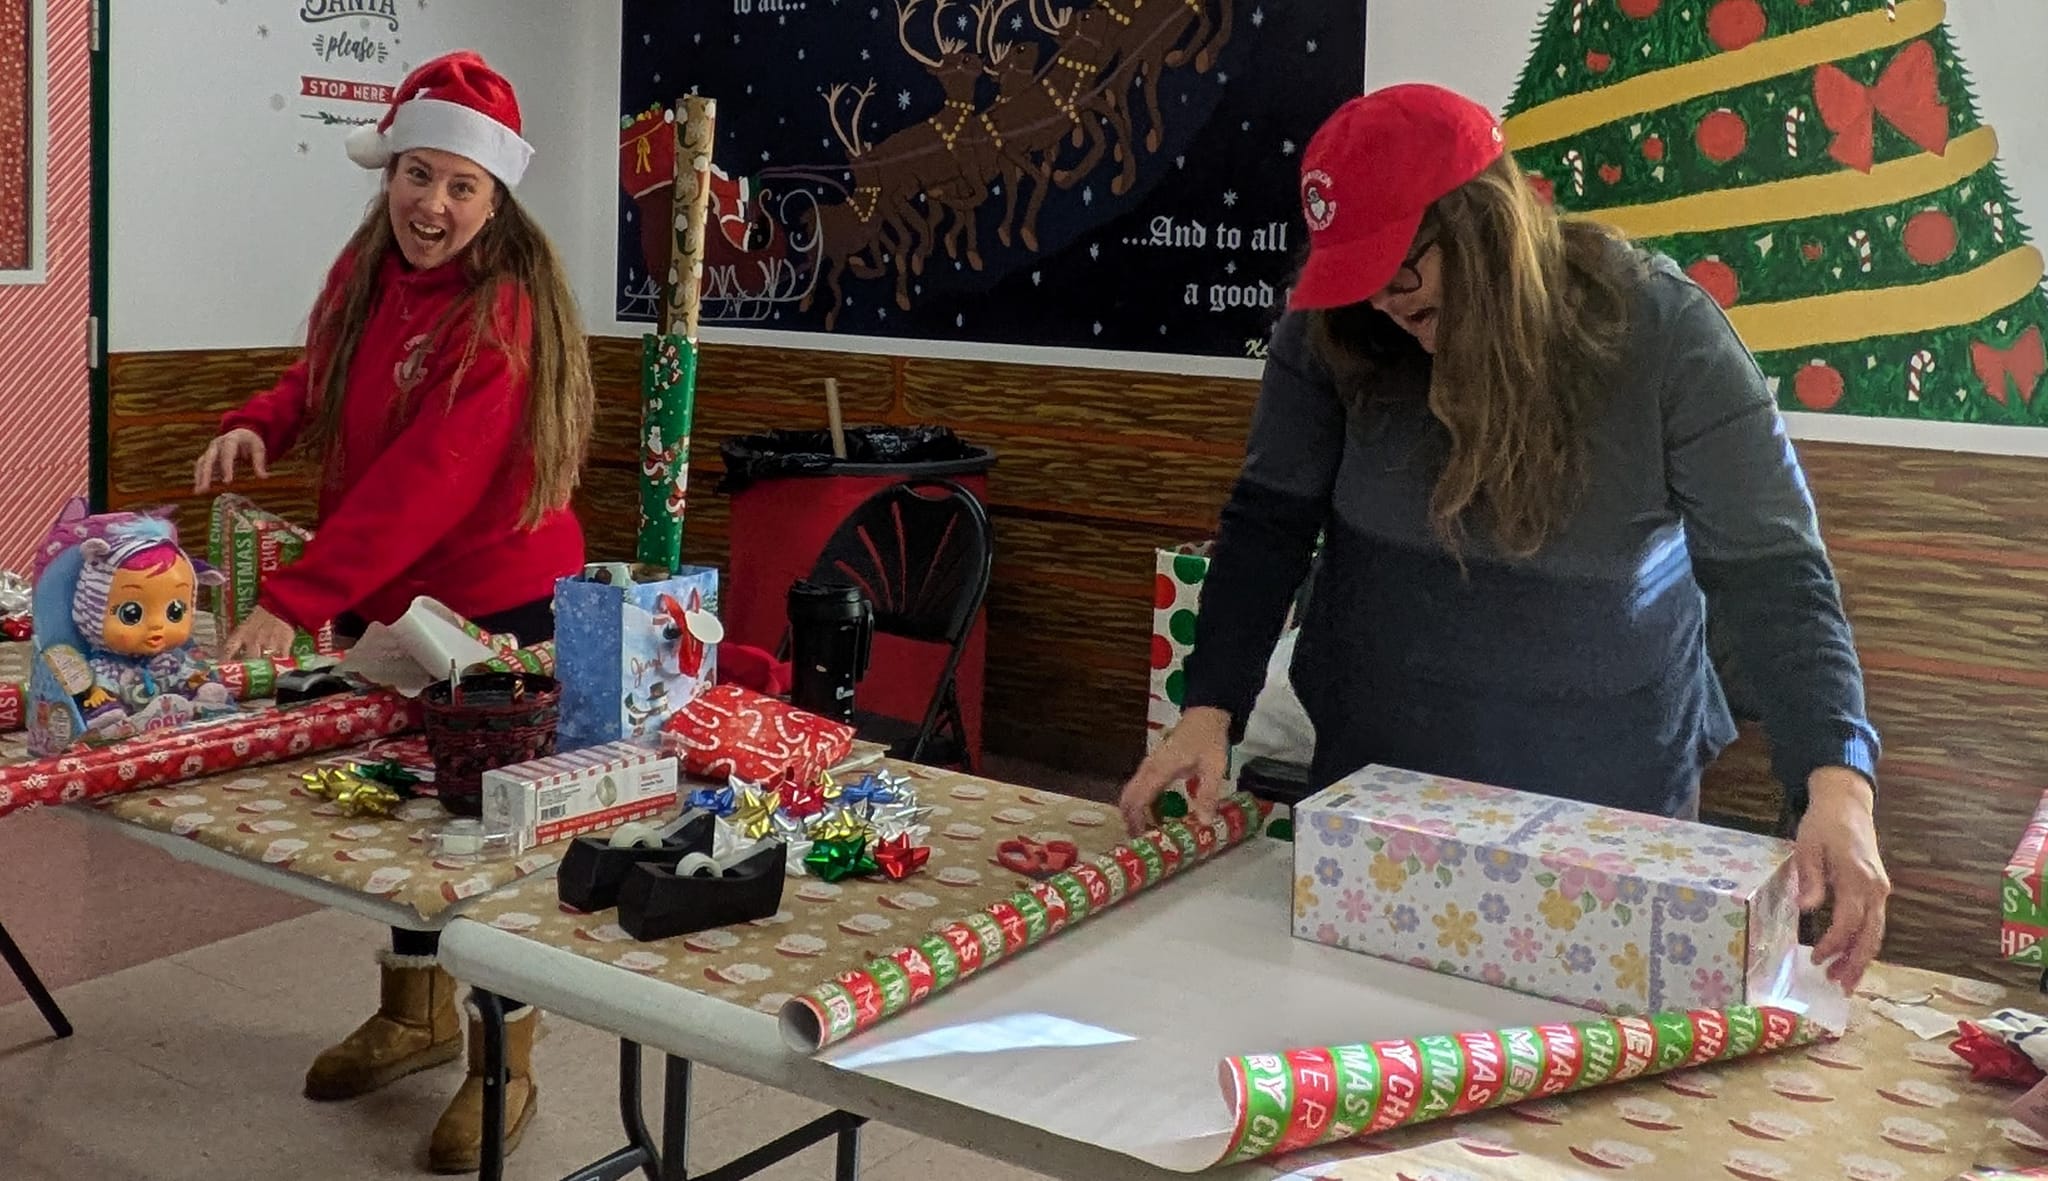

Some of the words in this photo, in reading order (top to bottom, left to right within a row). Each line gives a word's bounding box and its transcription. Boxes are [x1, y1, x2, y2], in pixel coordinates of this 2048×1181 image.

[325, 31, 377, 62] please
[309, 81, 347, 97] STOP
[353, 85, 390, 102] HERE
[1216, 222, 1241, 250] to
[1251, 221, 1288, 251] all
[1184, 283, 1199, 305] a
[1209, 279, 1274, 312] good
